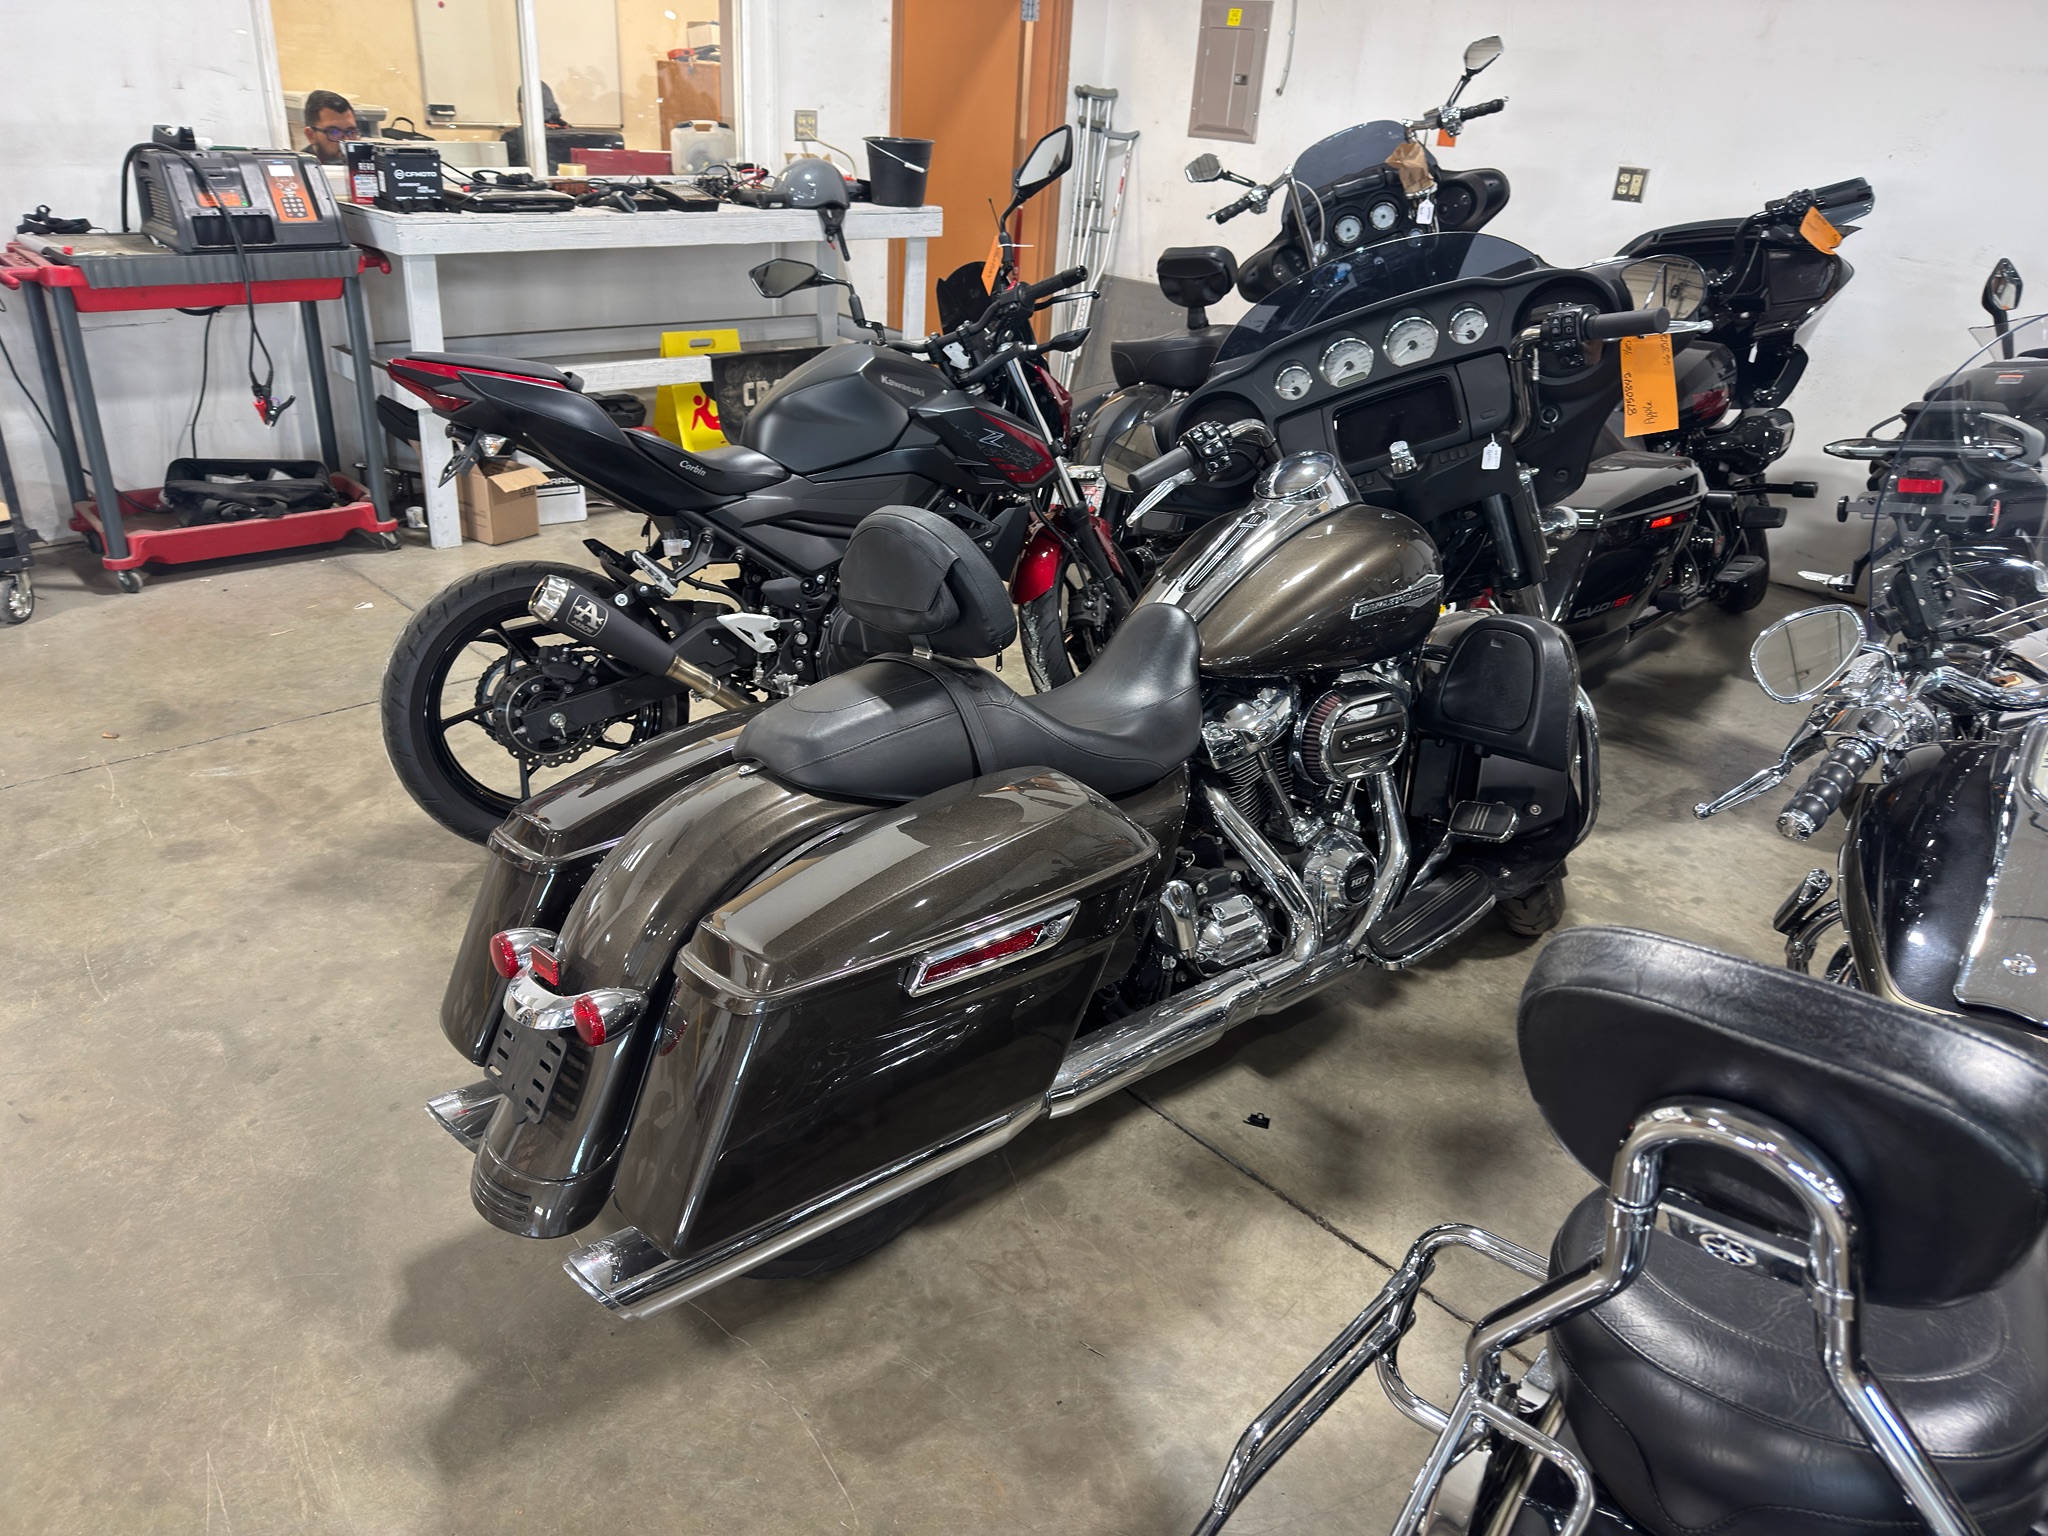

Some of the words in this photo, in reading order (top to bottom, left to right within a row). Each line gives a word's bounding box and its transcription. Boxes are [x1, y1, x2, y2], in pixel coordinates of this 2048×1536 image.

[880, 374, 926, 398] Kawasaki
[679, 460, 707, 476] Corbin
[1350, 874, 1370, 888] 107
